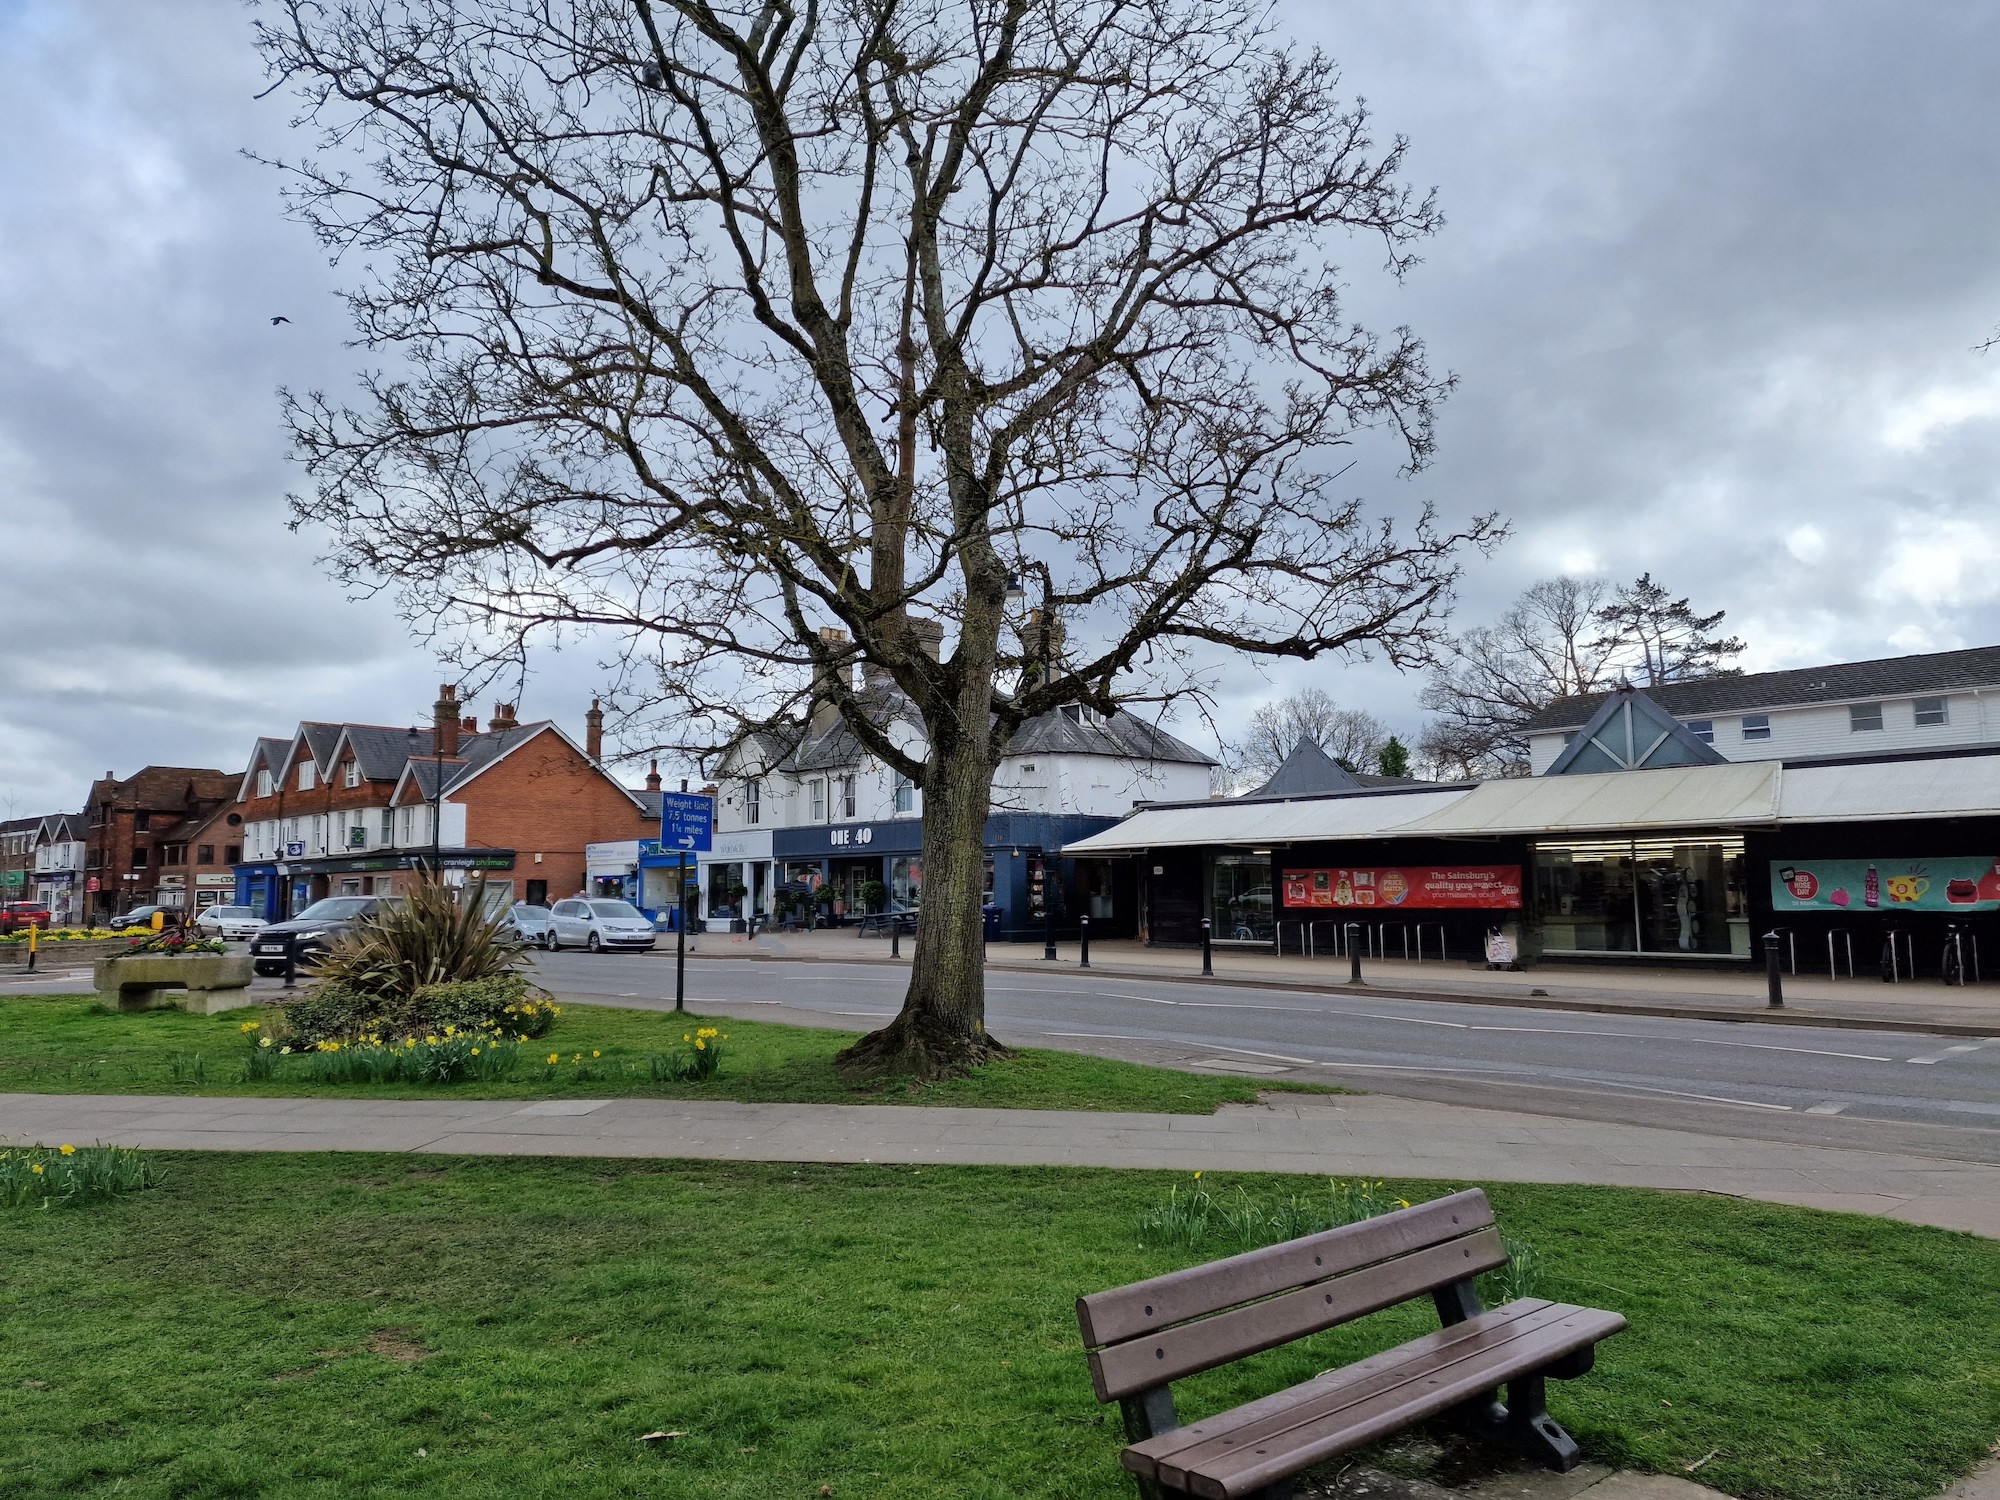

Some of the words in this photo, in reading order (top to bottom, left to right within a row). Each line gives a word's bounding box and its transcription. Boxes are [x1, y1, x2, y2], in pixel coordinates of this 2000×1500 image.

[666, 797, 692, 810] Weight
[668, 810, 680, 820] 7.5
[683, 813, 708, 823] tonnes
[684, 825, 704, 835] miles
[831, 829, 850, 846] ONE
[855, 827, 873, 845] 40
[443, 859, 475, 868] cranleigh
[1431, 872, 1446, 880] The
[1447, 871, 1496, 881] Sainsbury's
[1425, 881, 1454, 891] quality
